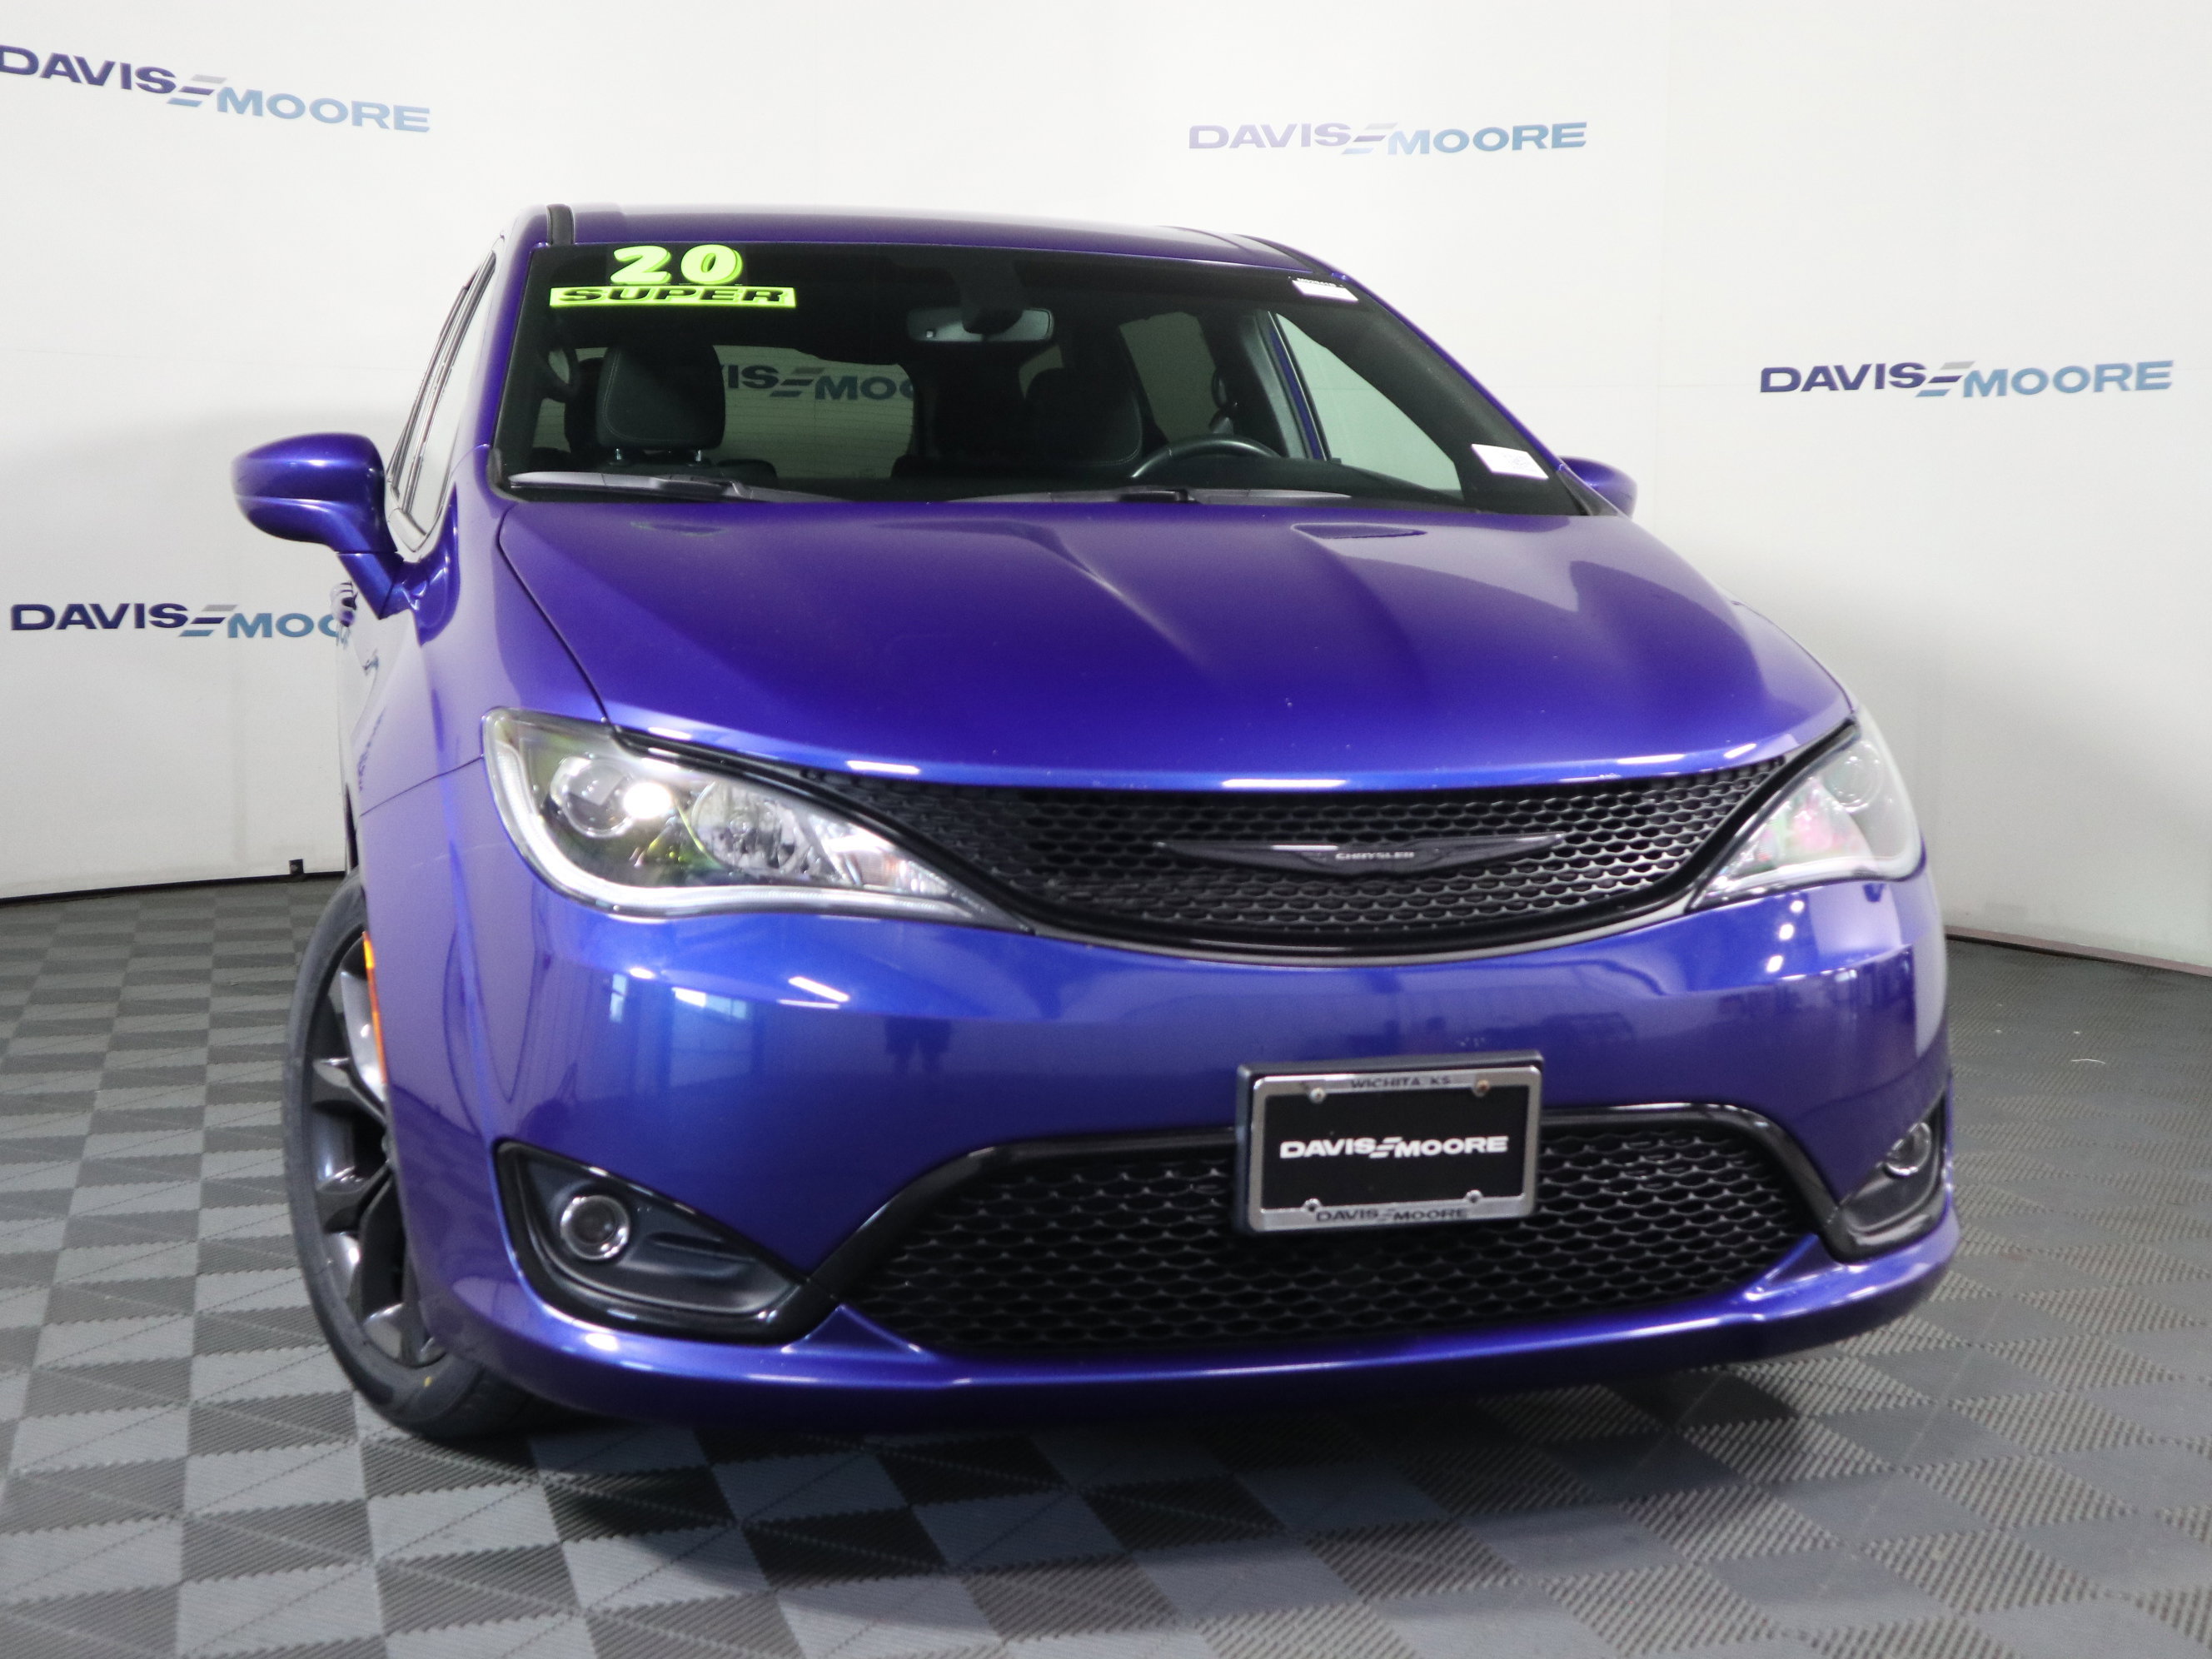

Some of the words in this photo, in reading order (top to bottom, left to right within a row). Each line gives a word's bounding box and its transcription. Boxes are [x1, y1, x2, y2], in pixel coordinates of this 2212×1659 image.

[0, 45, 177, 94] DAVIS
[217, 87, 431, 132] MOORE
[1189, 122, 1351, 149] DAVIS
[1387, 122, 1587, 156] MOORE
[610, 244, 743, 285] 20
[557, 286, 788, 304] SUPER
[721, 365, 780, 389] IS
[1760, 361, 1926, 393] DAVIS
[1963, 360, 2175, 398] MOORE
[10, 603, 188, 630] DAVIS
[1335, 852, 1415, 860] CHRYSLER
[1350, 1077, 1420, 1089] WICHITA
[1430, 1075, 1451, 1085] KS
[1280, 1138, 1373, 1158] DAVIS
[1394, 1136, 1509, 1158] MOORE
[1316, 1209, 1378, 1223] DAVIS
[1393, 1208, 1467, 1222] MOORE
